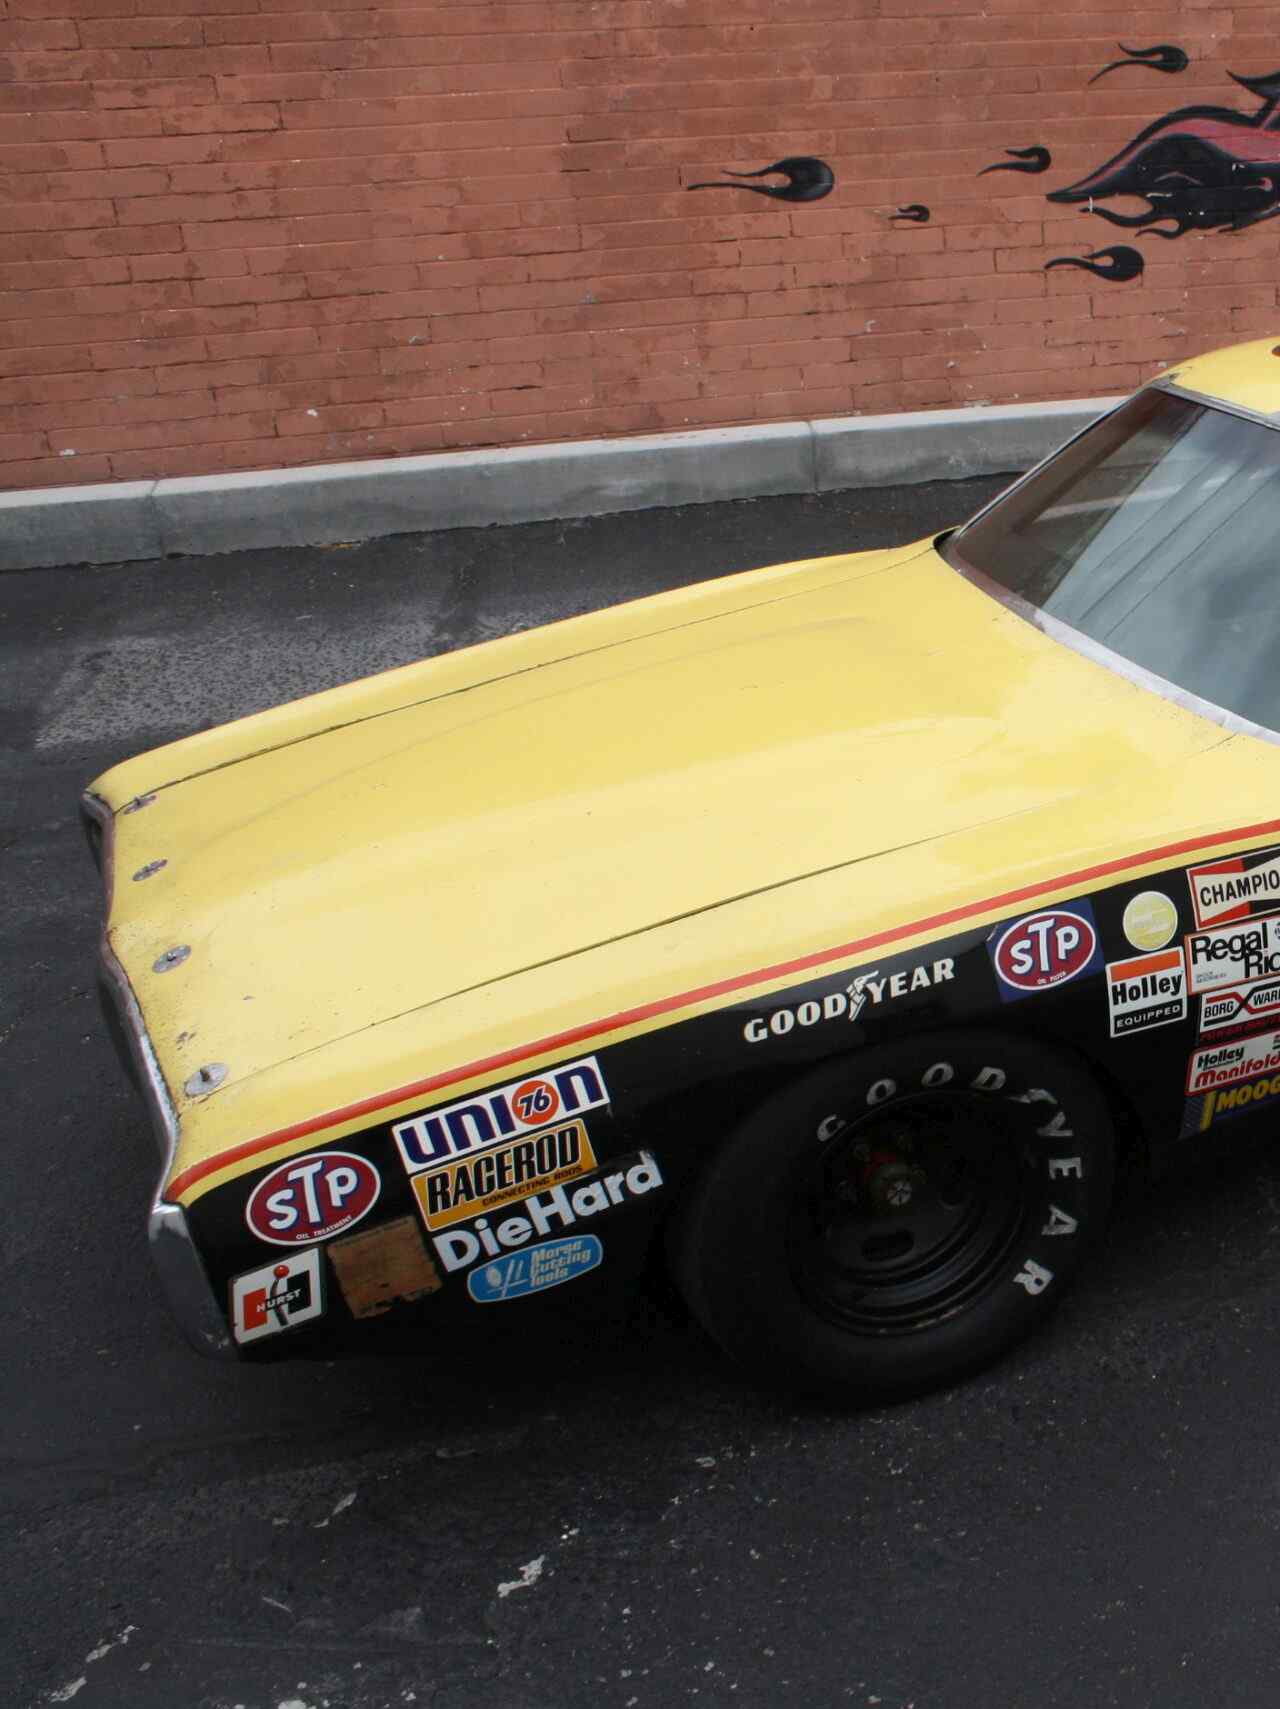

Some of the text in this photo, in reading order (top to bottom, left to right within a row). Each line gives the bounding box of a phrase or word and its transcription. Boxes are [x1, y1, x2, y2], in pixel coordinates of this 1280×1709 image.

[1009, 917, 1080, 975] STP
[1190, 921, 1268, 965] Regal
[743, 957, 955, 1044] GOODYEAR
[1111, 974, 1183, 1006] Holley
[1204, 1001, 1235, 1019] BORG
[1116, 1004, 1182, 1028] EQUIPPED
[1197, 1046, 1245, 1069] Holley
[518, 1084, 551, 1121] 76
[426, 1125, 582, 1216] RACEROD
[816, 1061, 1083, 1296] GOODYEAR
[266, 1160, 358, 1230] STP
[432, 1149, 664, 1273] DieHard
[296, 1215, 352, 1241] OIL TREATMENT
[256, 1288, 302, 1312] HURST
